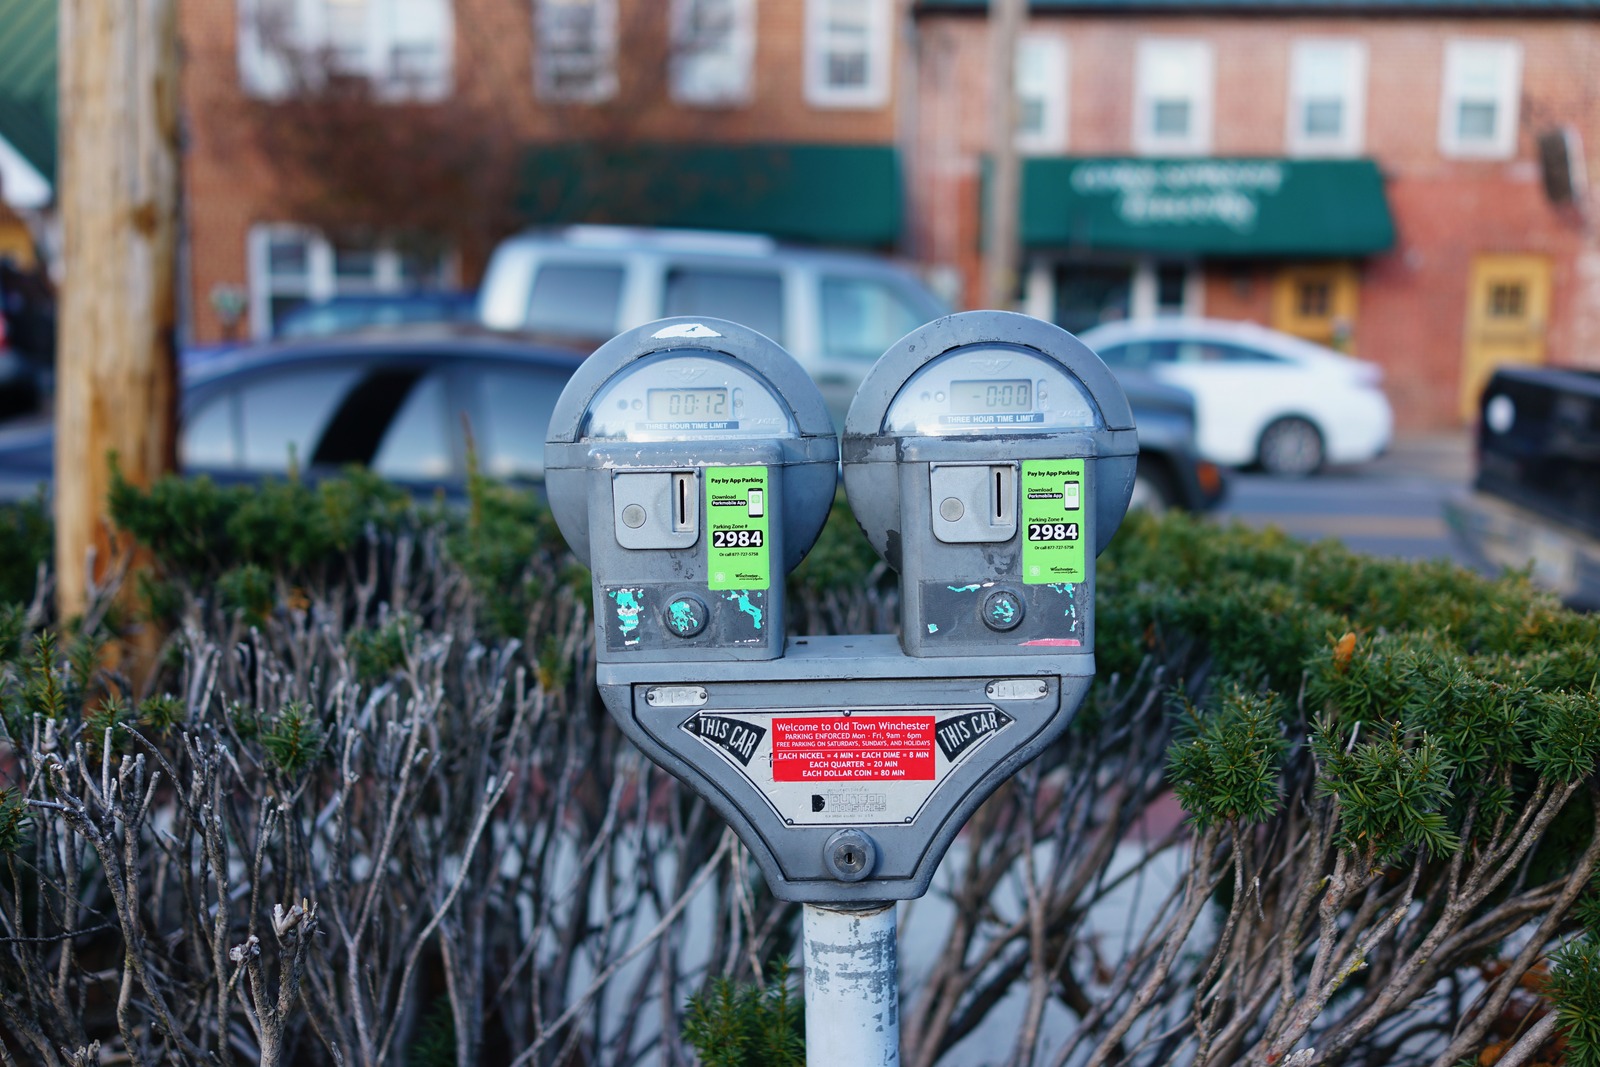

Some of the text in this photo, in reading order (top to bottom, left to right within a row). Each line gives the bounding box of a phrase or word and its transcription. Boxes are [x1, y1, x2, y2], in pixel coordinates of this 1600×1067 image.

[670, 393, 726, 415] 00:12
[692, 422, 708, 430] TIME
[973, 415, 994, 423] HOUR
[1016, 414, 1034, 422] LIMIT
[714, 531, 762, 547] 2984
[1029, 524, 1078, 540] 2984
[776, 721, 930, 731] Welcome to Old Town Winchester
[938, 712, 998, 753] THIS CAR
[699, 718, 758, 759] THIS CAR
[907, 732, 922, 740] 6pm
